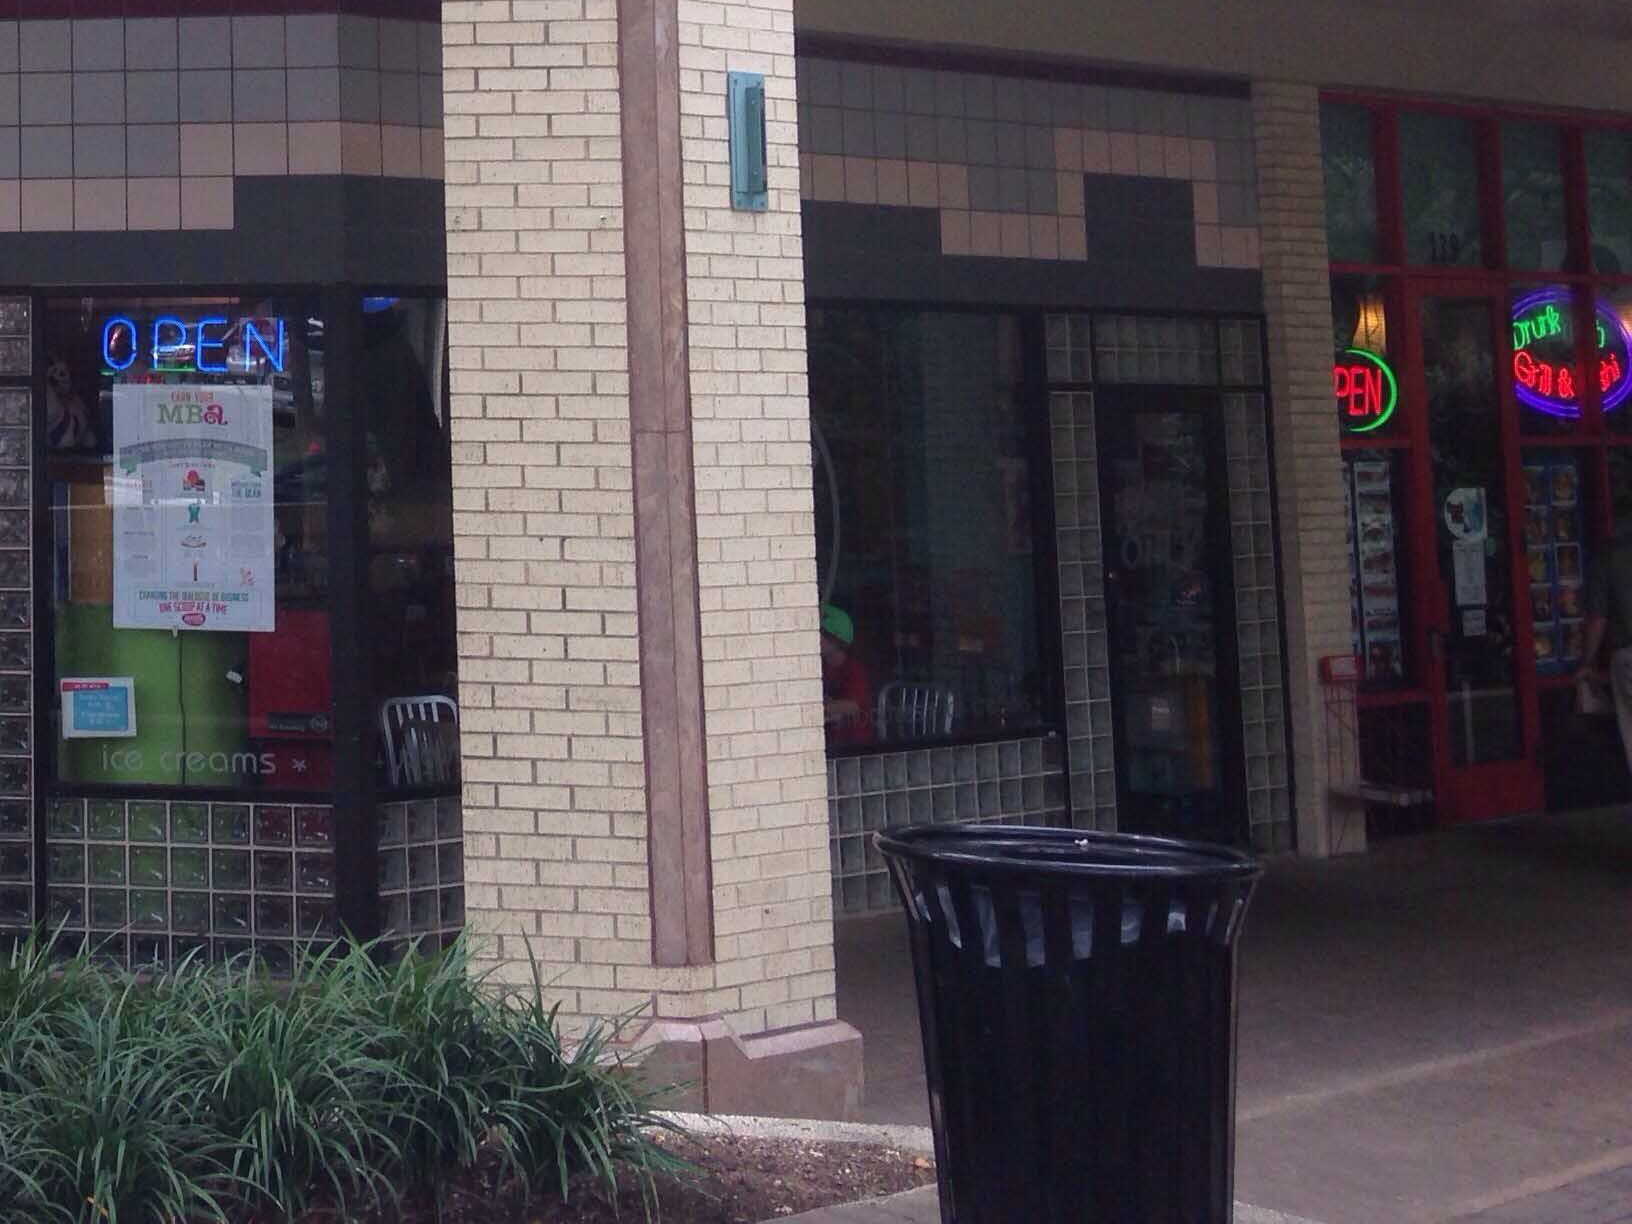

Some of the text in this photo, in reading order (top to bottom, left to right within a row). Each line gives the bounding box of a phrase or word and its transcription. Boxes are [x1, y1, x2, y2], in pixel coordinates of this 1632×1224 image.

[103, 317, 284, 373] OPEN
[1333, 366, 1382, 416] PEN
[101, 744, 277, 775] ice creams
